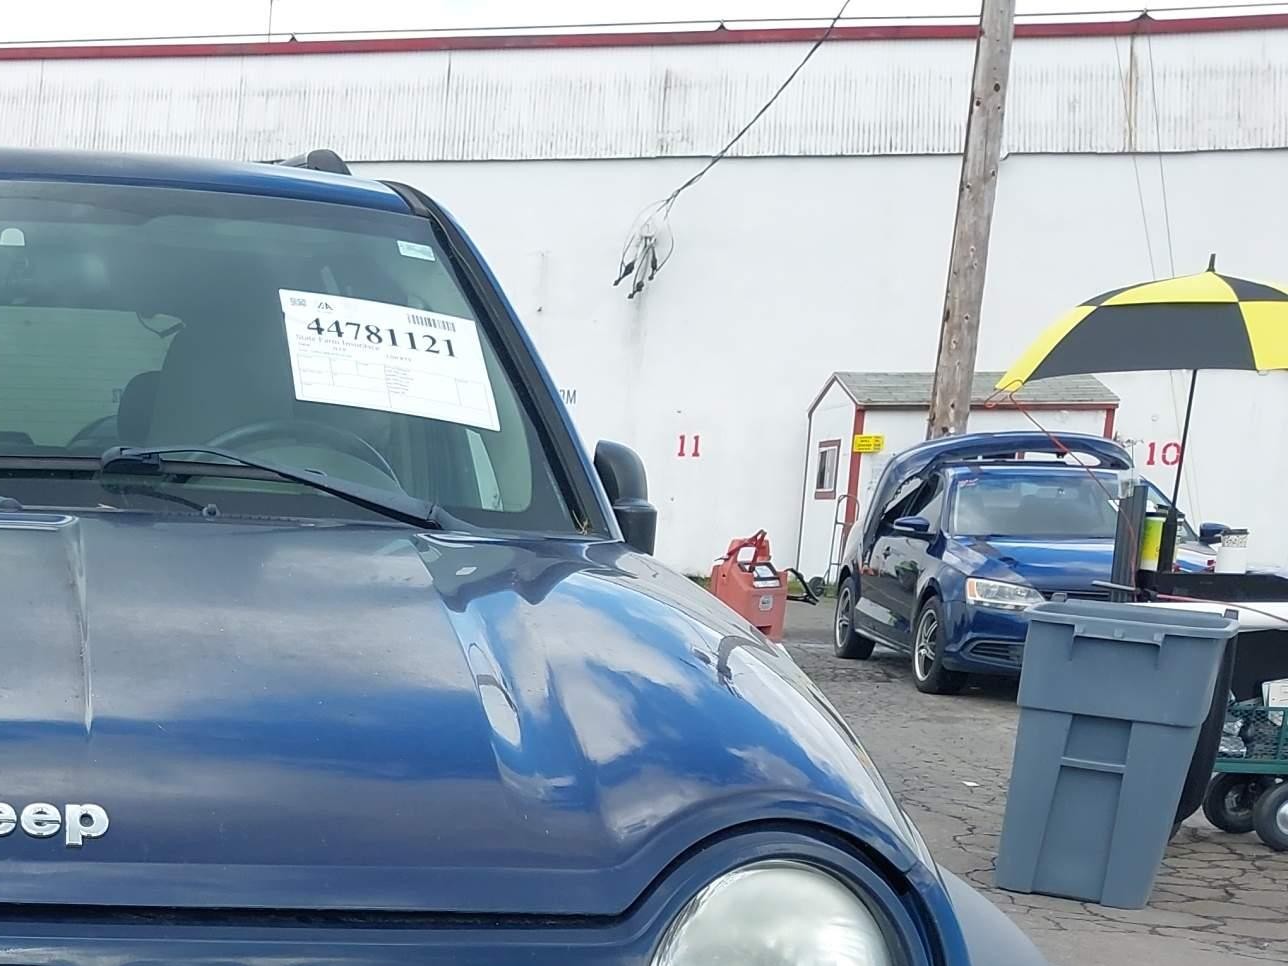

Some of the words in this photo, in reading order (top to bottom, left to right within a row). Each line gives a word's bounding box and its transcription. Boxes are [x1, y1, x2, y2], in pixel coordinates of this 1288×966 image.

[307, 318, 458, 358] 44781121
[678, 435, 700, 457] 11
[1147, 442, 1181, 466] 10
